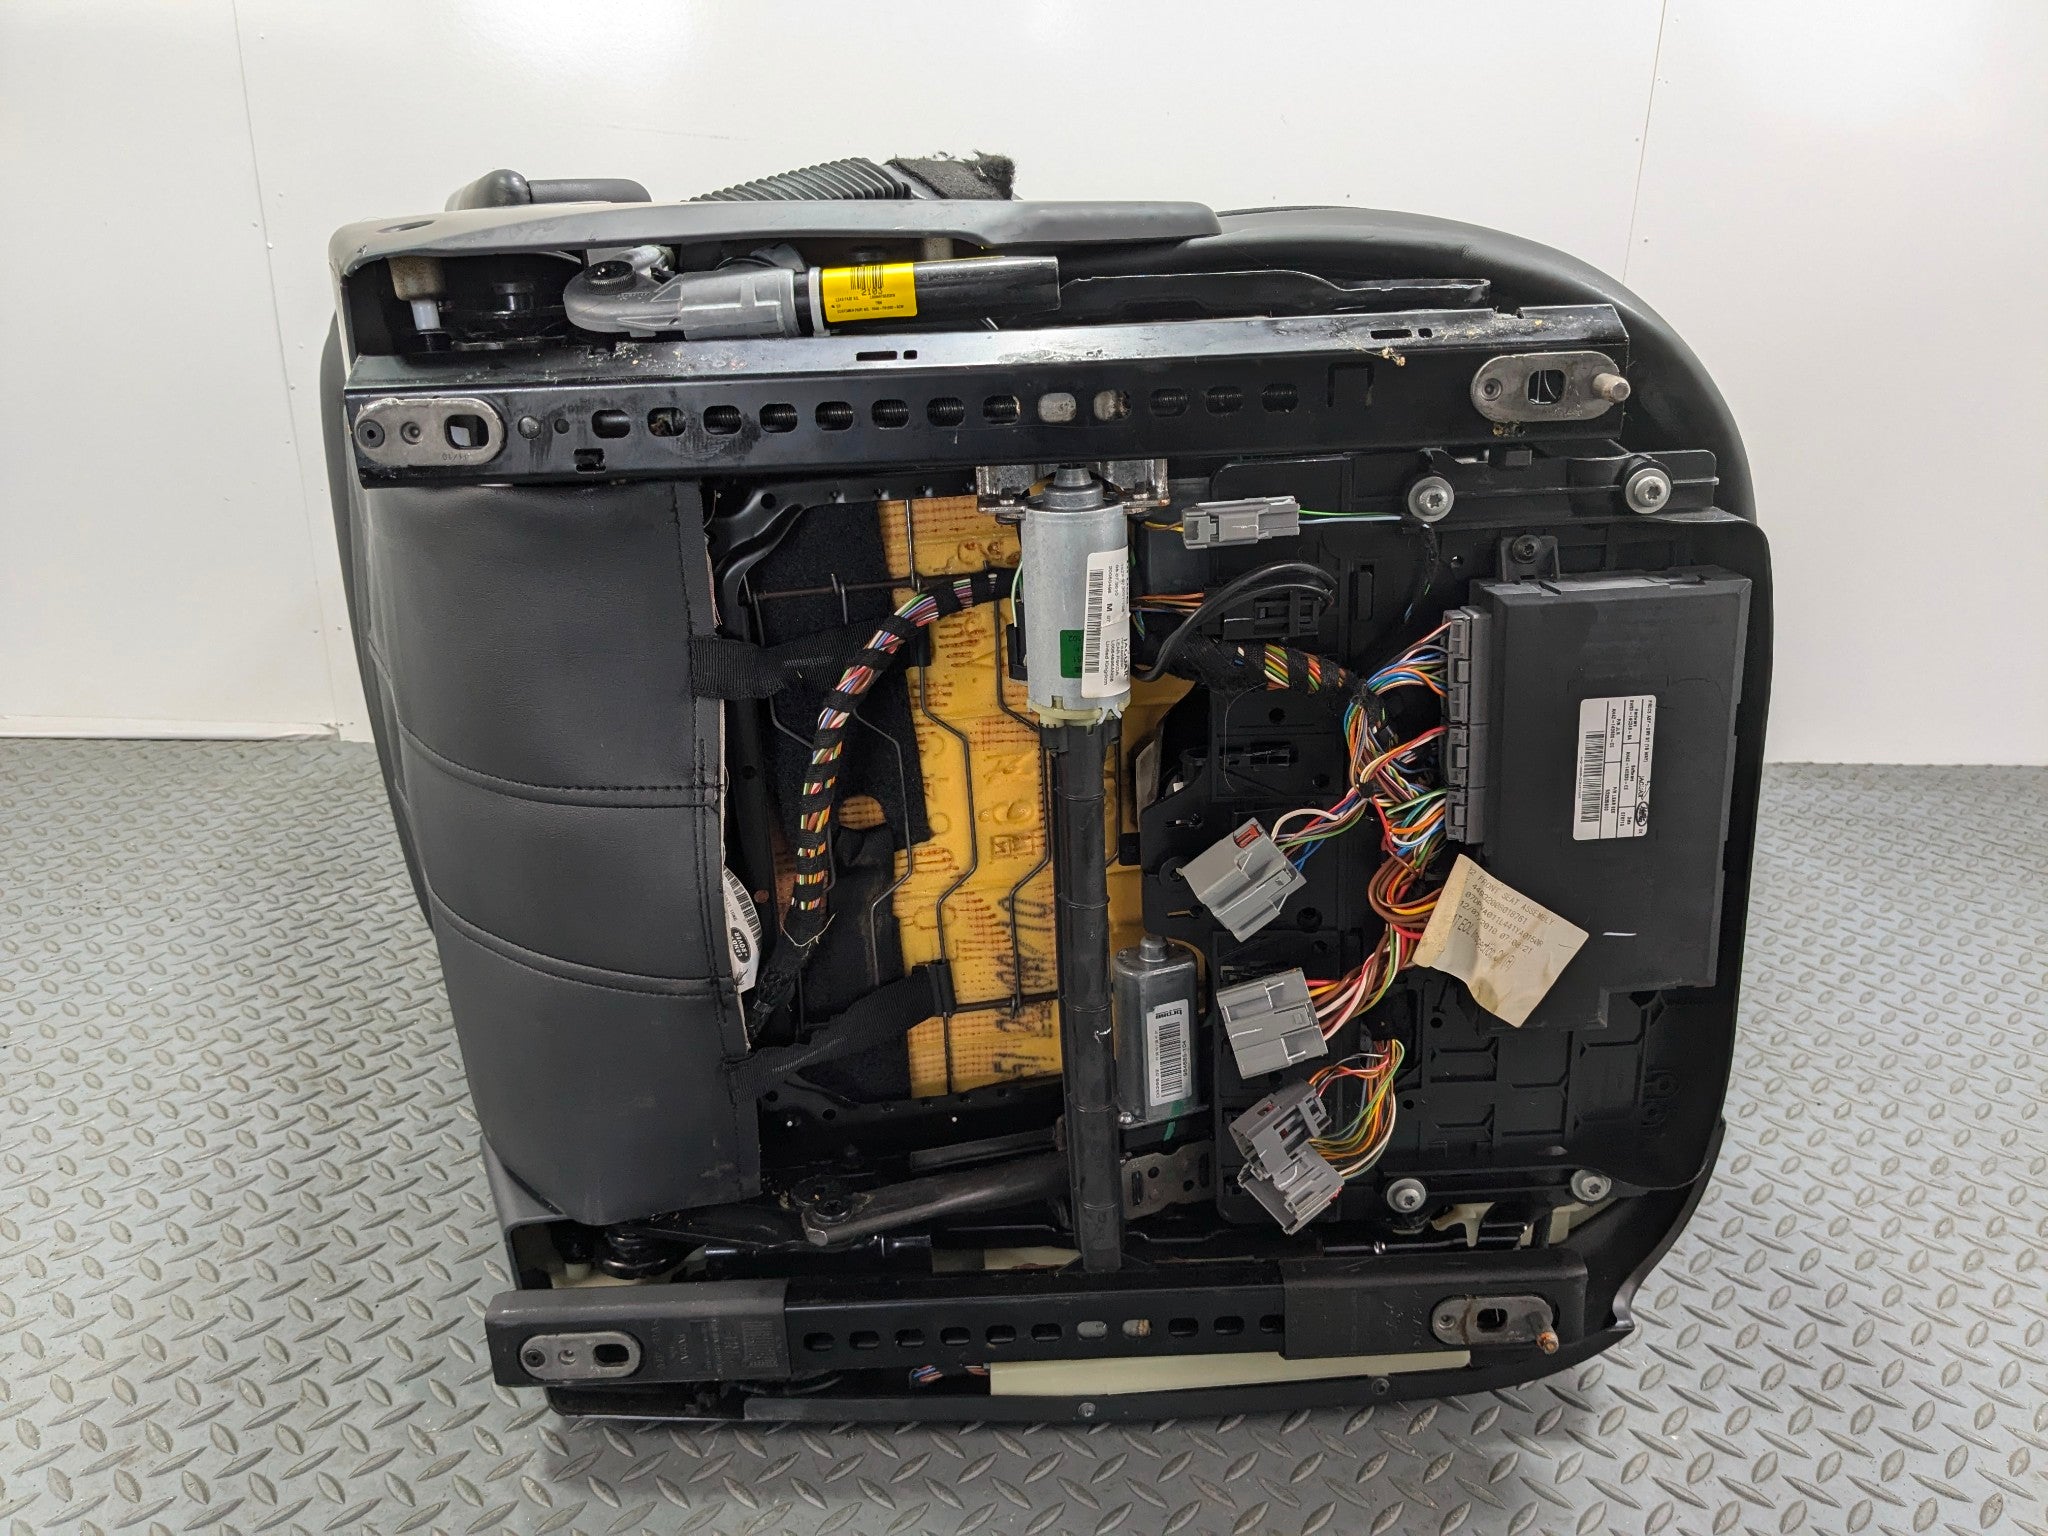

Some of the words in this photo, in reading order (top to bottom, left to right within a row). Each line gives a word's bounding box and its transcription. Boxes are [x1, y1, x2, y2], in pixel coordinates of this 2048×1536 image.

[1106, 604, 1112, 612] M
[1501, 892, 1520, 905] SEAT
[1520, 902, 1555, 926] ASSEMBLY
[735, 932, 748, 952] ROVER
